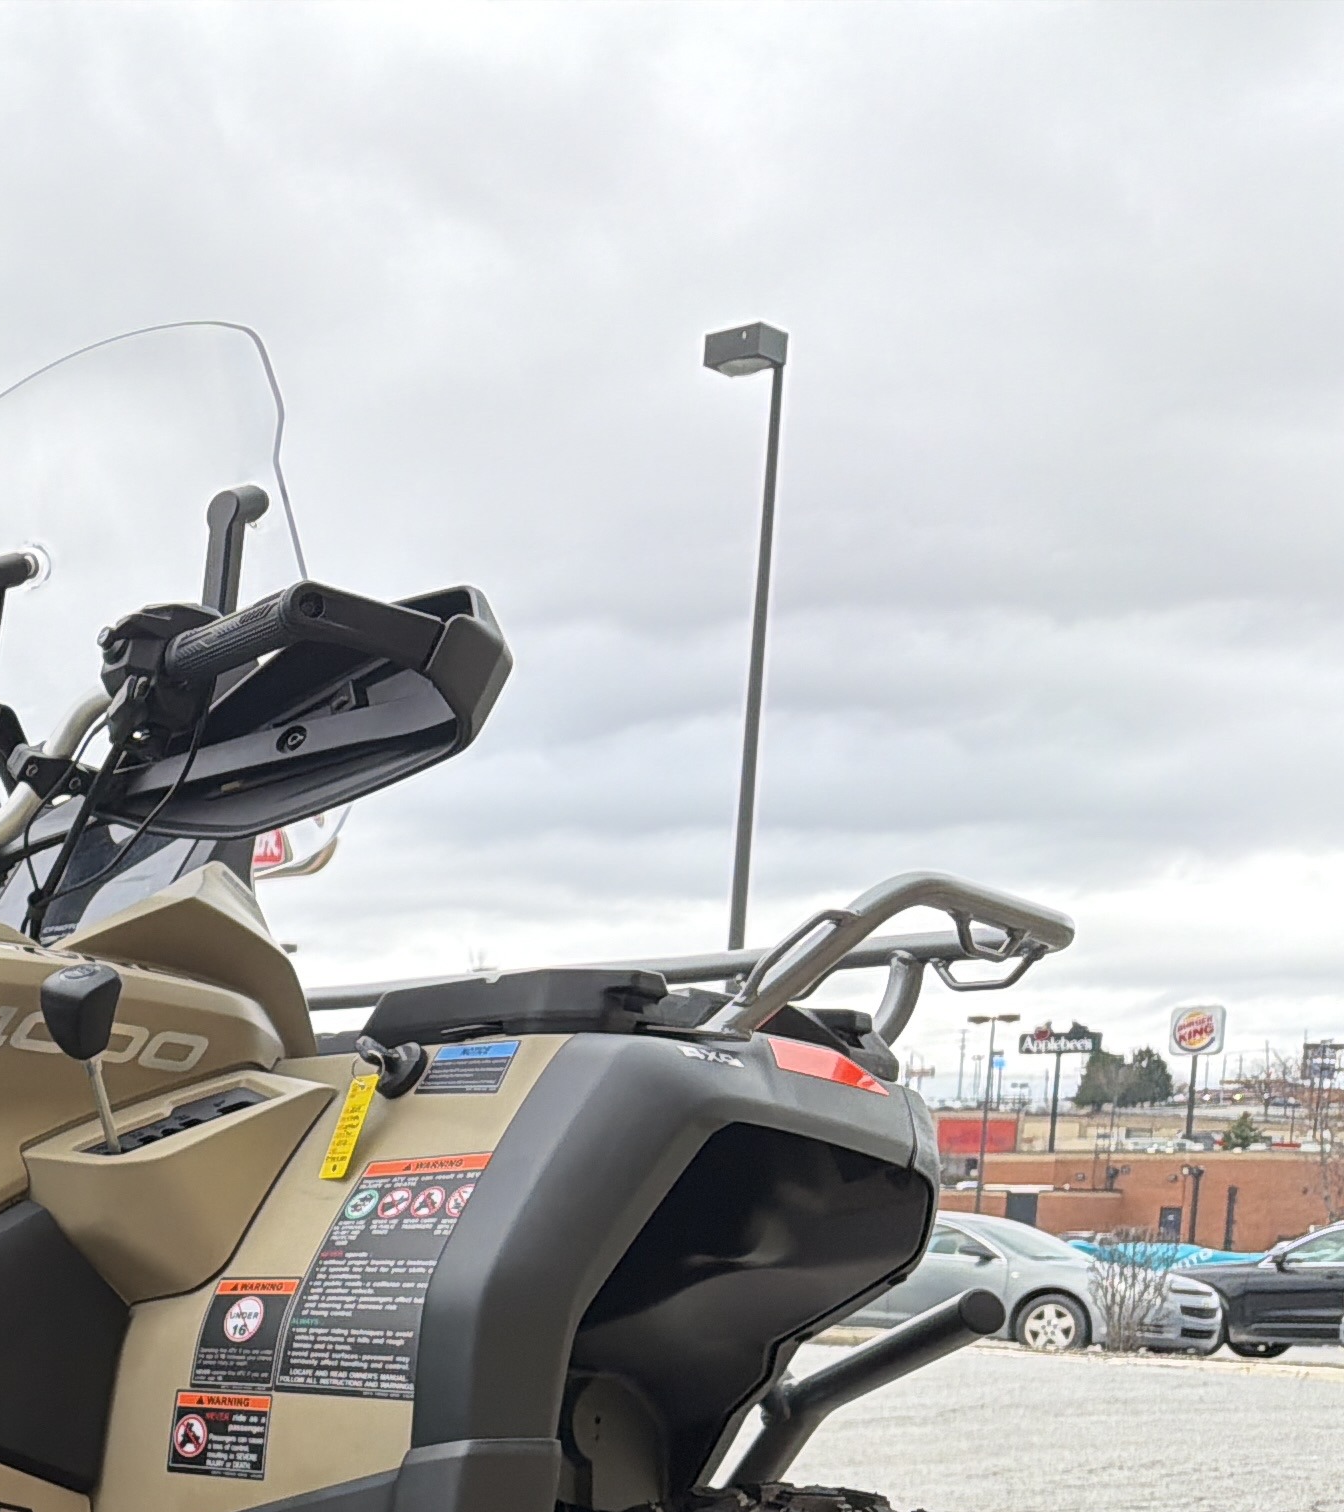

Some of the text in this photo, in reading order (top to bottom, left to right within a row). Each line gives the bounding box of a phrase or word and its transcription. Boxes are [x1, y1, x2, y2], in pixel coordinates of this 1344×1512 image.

[1178, 1023, 1215, 1044] KING
[416, 1159, 464, 1169] WARNING
[240, 1283, 284, 1291] WARNING
[229, 1311, 259, 1320] UNDER
[232, 1324, 247, 1336] 16
[207, 1396, 250, 1407] WARNING
